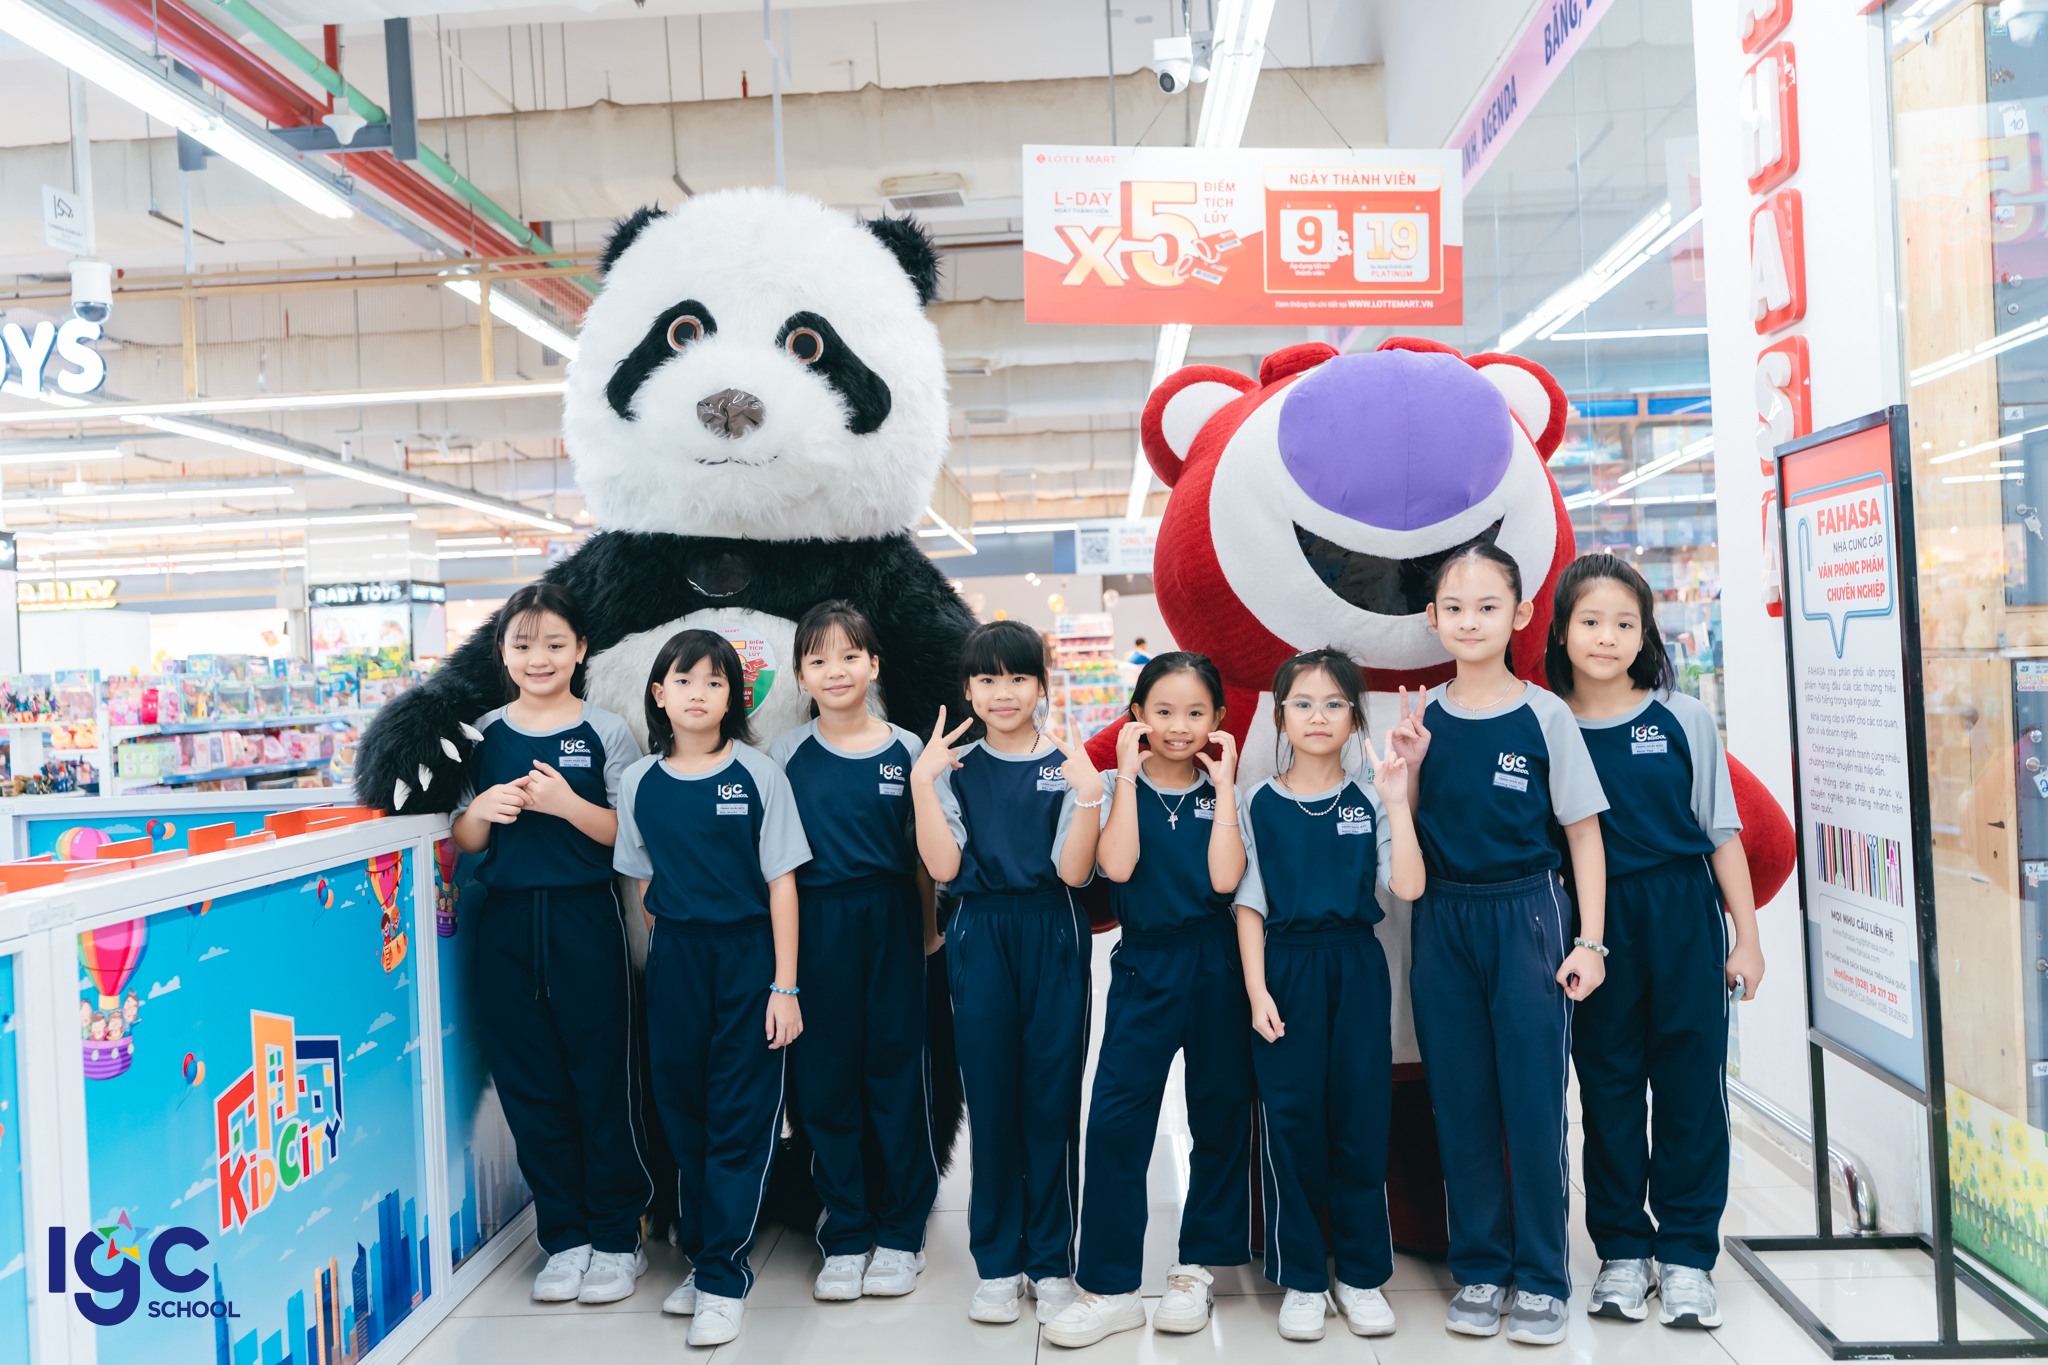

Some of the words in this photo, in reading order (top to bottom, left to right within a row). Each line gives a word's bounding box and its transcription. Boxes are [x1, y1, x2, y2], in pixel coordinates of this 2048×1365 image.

[1481, 75, 1518, 154] AGENDA
[2010, 118, 2024, 131] 10
[1048, 155, 1081, 163] LOTTE
[1085, 155, 1117, 163] MART
[1204, 179, 1236, 192] ĐIỂM
[1289, 172, 1329, 185] NGÀY
[1332, 171, 1380, 185] THÀNH
[1384, 171, 1416, 185] VIÊN
[1054, 191, 1112, 206] L-DAY
[1204, 195, 1234, 208] TÍCH
[1204, 210, 1228, 223] LŨY
[1296, 215, 1323, 255] 9
[1332, 229, 1353, 257] &
[1367, 220, 1418, 260] 19
[1348, 300, 1433, 308] WWW.LOTTEMART.VN
[0, 318, 106, 396] YS
[1817, 498, 1881, 536] FAHASA
[1833, 538, 1847, 553] NHÀ
[1848, 537, 1867, 551] CUNG
[1869, 531, 1883, 548] CẤP
[1834, 558, 1859, 577] PHÒNG
[1862, 552, 1885, 574] PHẨM
[314, 585, 359, 604] BABY
[360, 584, 402, 602] TOYS
[1827, 582, 1855, 602] CHUYÊN
[1857, 579, 1885, 601] NGHIỆP
[1831, 910, 1842, 923] MỌI
[1843, 915, 1855, 927] NHU
[1870, 923, 1883, 938] LIÊN
[1885, 928, 1894, 944] HỆ
[1834, 968, 1854, 984] Hotline:
[1855, 976, 1868, 993] (028)
